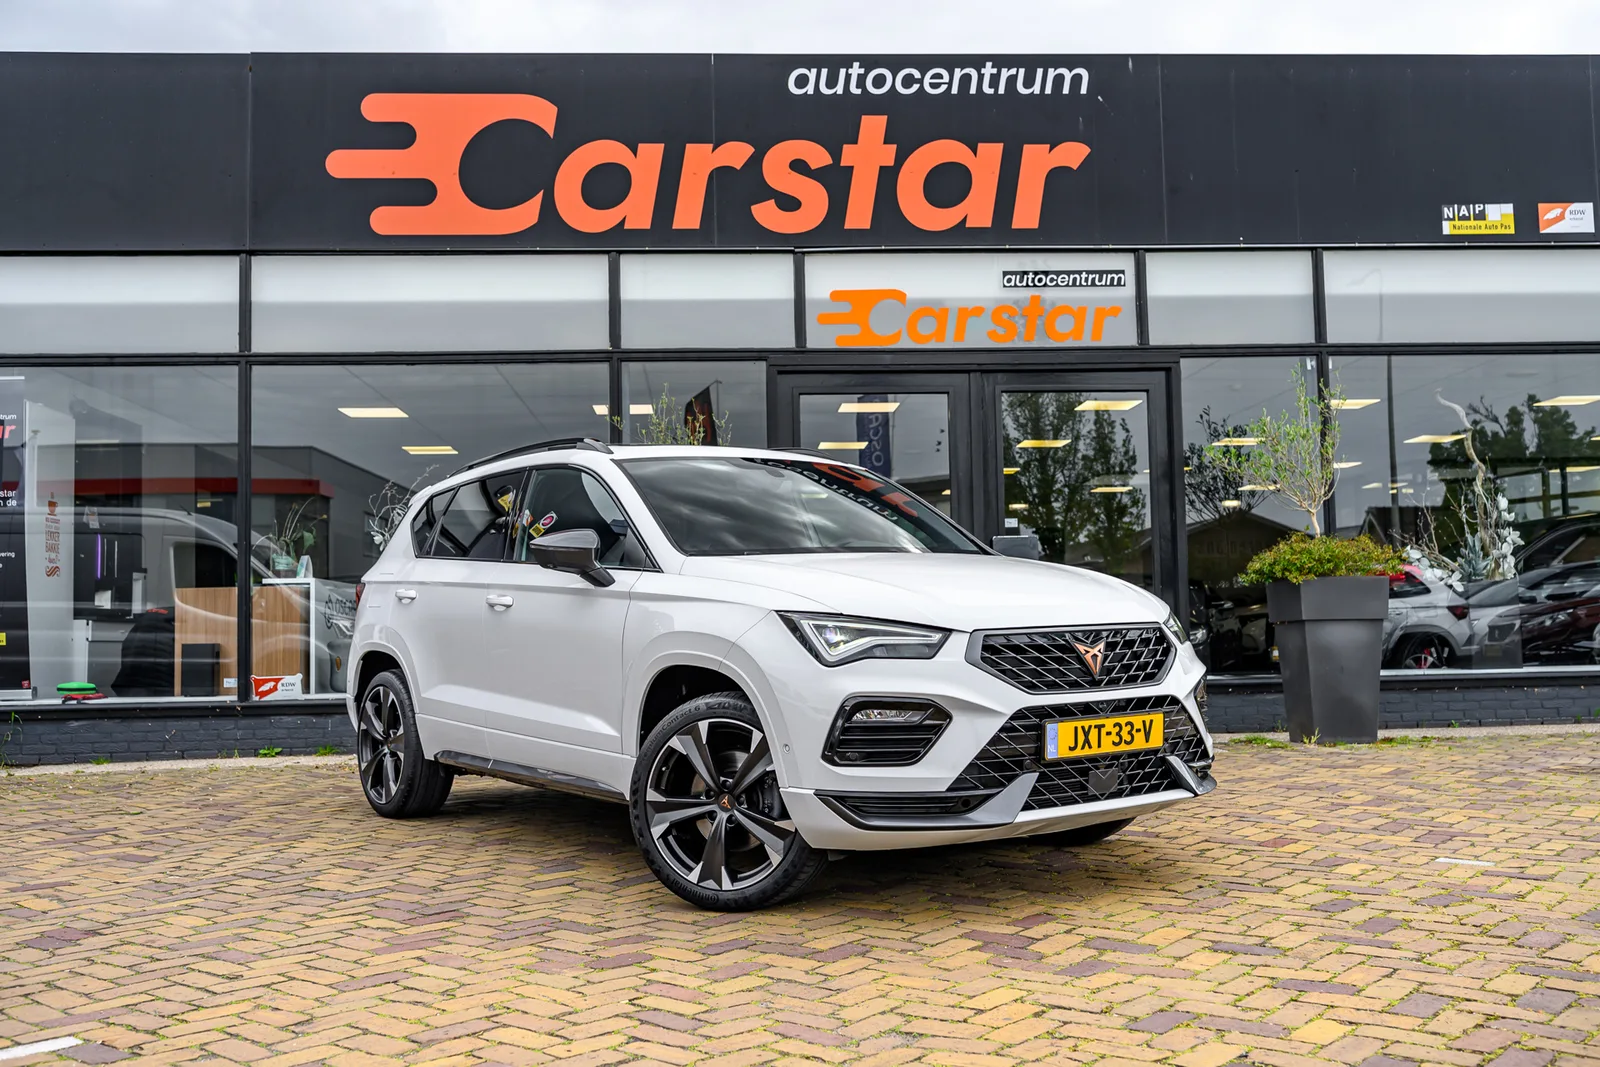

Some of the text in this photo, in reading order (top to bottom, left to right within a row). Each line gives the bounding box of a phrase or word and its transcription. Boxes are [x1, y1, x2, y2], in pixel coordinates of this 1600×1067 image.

[788, 62, 1089, 95] autocentrum
[325, 93, 1091, 235] Carstar
[1500, 222, 1512, 230] Pas
[1003, 270, 1125, 287] autocentrum
[816, 289, 1123, 347] Carstar
[6, 498, 17, 507] de
[1068, 719, 1154, 752] JXT-33-V
[1047, 744, 1057, 753] NL
